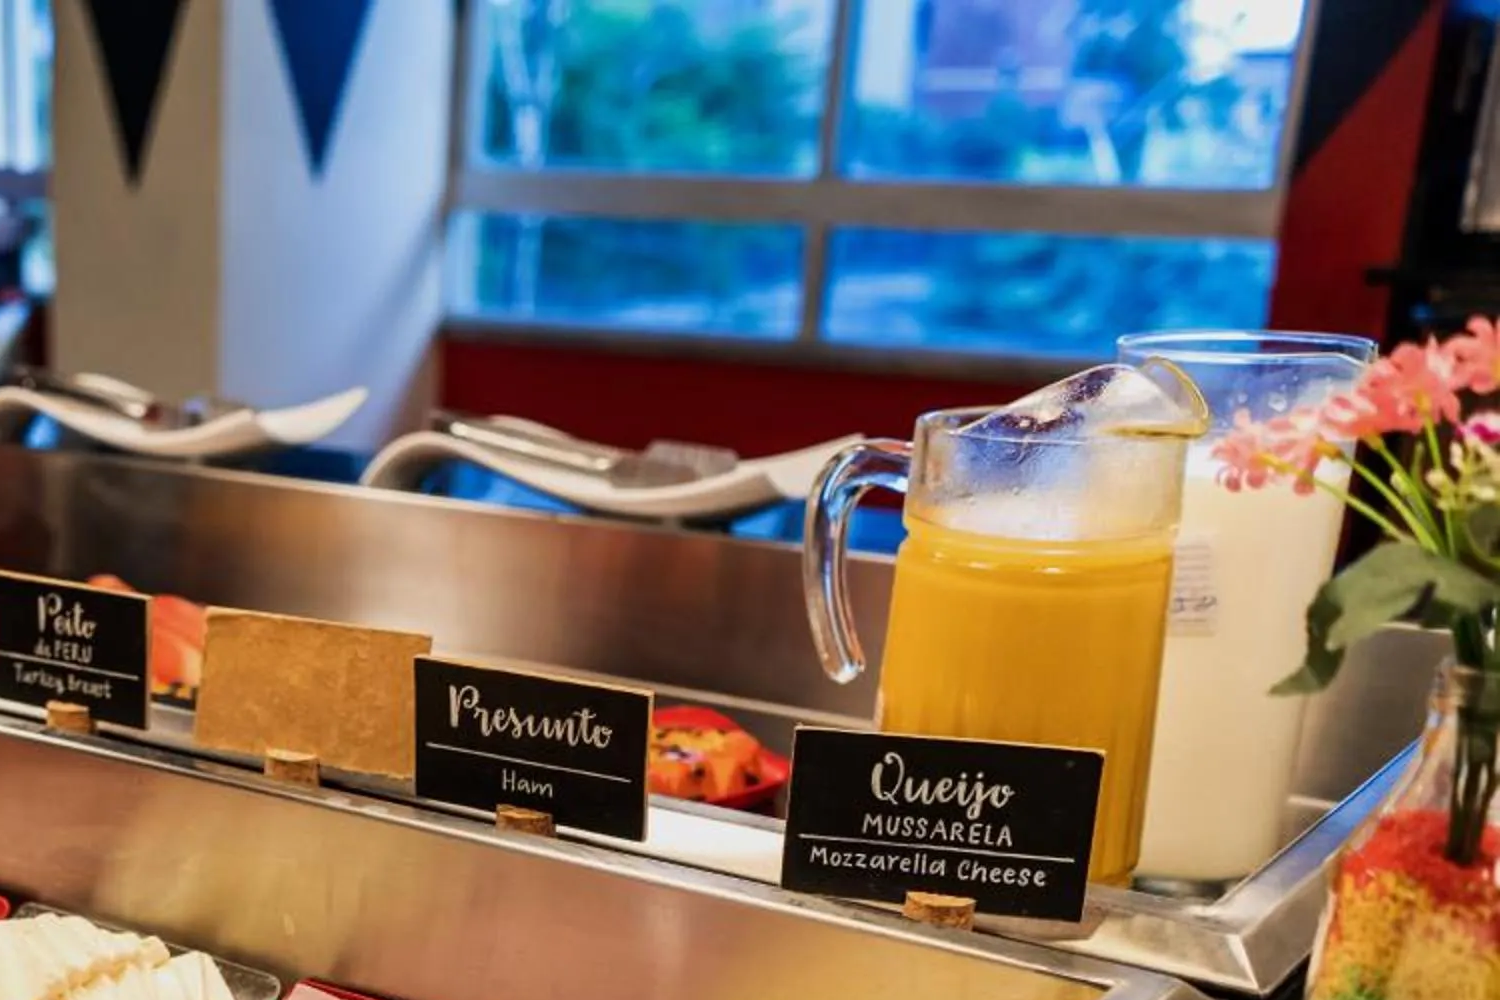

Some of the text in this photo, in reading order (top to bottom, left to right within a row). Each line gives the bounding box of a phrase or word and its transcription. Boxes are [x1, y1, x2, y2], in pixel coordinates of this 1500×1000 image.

[38, 593, 97, 638] Peito
[13, 662, 64, 695] Turkey
[449, 684, 613, 749] Presunto
[501, 767, 554, 797] Ham
[870, 751, 1016, 820] Queijo
[861, 812, 1014, 847] MUSSARELA
[809, 845, 1049, 888] Mozzarella Cheese
